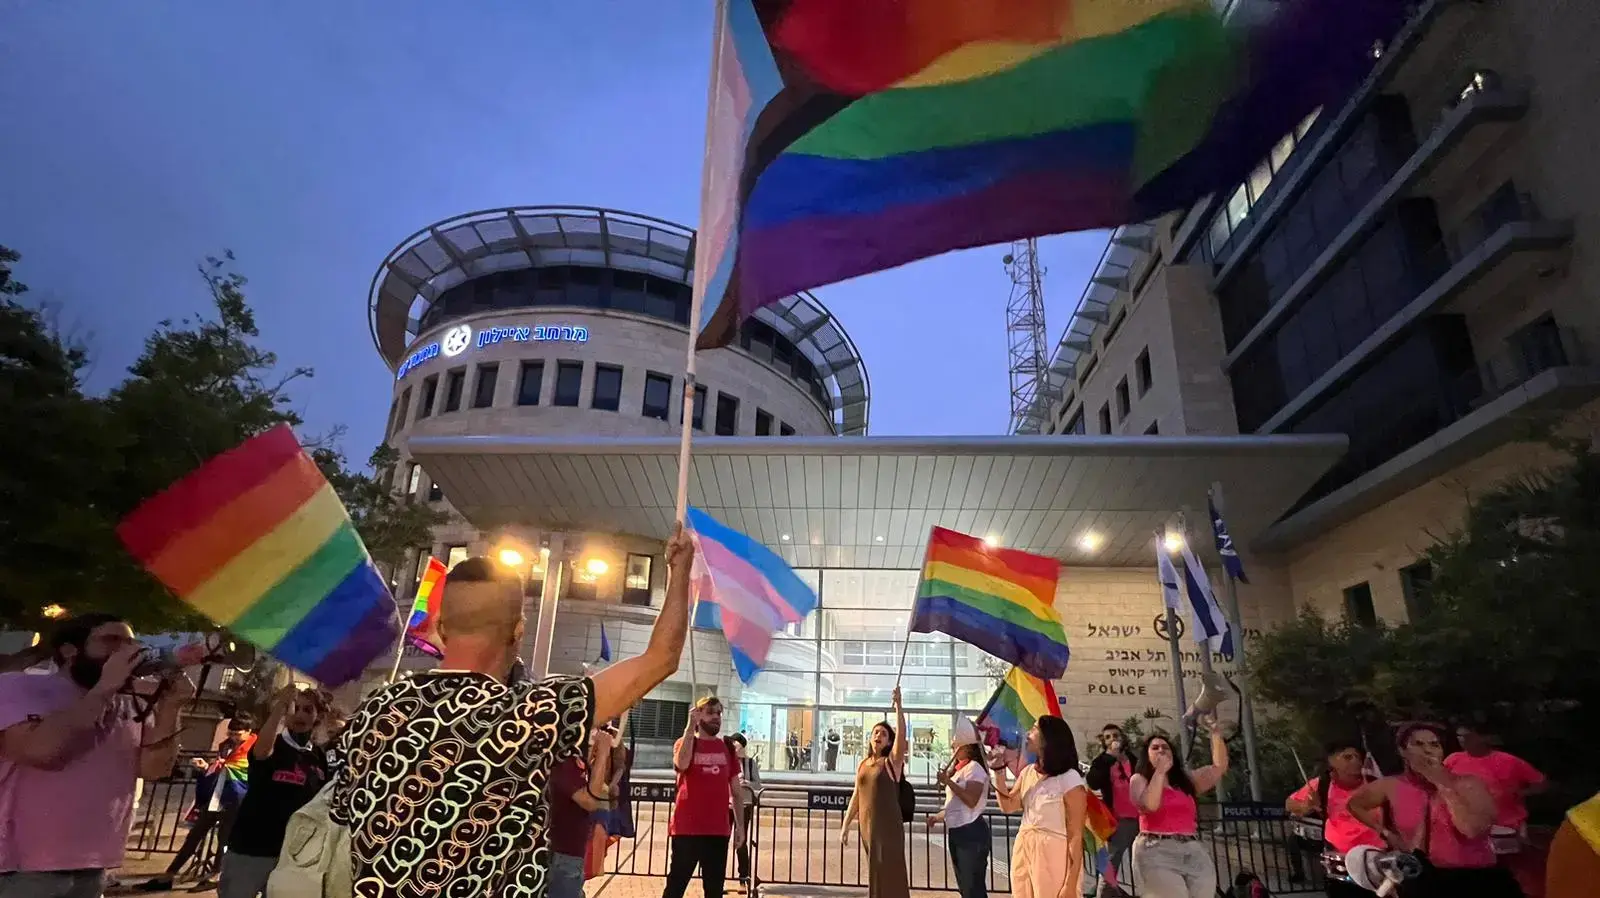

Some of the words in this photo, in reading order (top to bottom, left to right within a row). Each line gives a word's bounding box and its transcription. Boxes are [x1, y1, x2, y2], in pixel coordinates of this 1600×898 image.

[477, 326, 531, 347] איילון
[534, 325, 588, 342] מרחב
[1088, 623, 1140, 638] ישראל
[1105, 650, 1140, 662] אביב
[1147, 650, 1166, 662] תל
[1108, 669, 1145, 679] קראוס
[1150, 669, 1168, 678] דוד
[1088, 684, 1147, 695] POLICE
